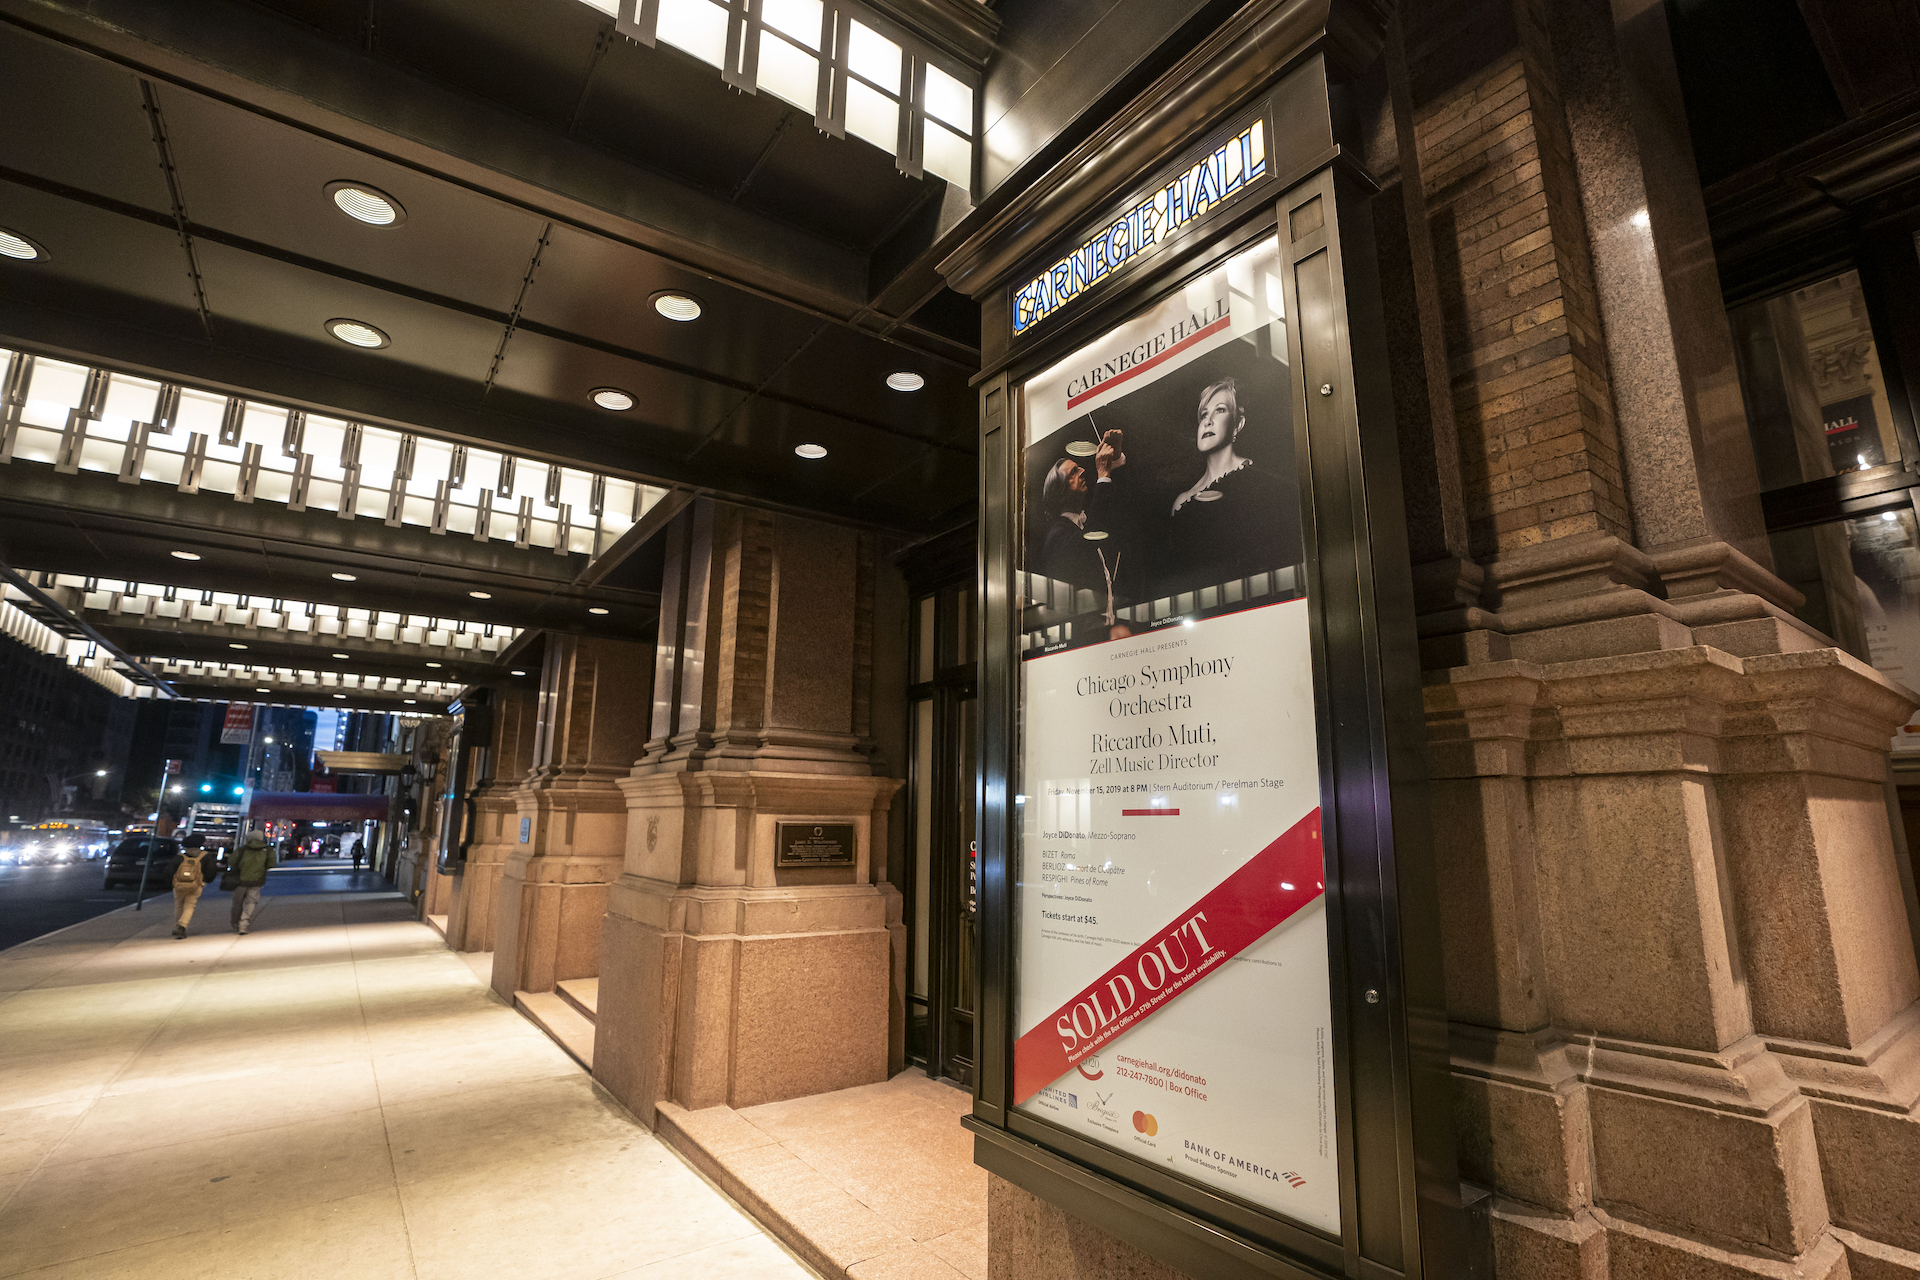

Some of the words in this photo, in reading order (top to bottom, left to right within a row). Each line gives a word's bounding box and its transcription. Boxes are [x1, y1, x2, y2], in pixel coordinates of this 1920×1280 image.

[1014, 202, 1155, 331] CARNEGIE
[1166, 132, 1266, 230] HALL
[1067, 332, 1166, 398] CARNEGIE
[1170, 297, 1230, 346] HALL
[1150, 620, 1162, 628] Joyce
[1110, 649, 1139, 661] CARNEGIE
[1140, 646, 1156, 655] HALL
[1157, 639, 1188, 651] PRESENTS
[1076, 673, 1136, 696] Chicago
[1140, 656, 1235, 688] Symphony
[1109, 693, 1193, 718] Orchestra
[1091, 727, 1163, 753] Riccardo
[1167, 722, 1217, 746] Muti,
[1089, 757, 1112, 775] Zell
[1115, 756, 1155, 773] Music
[1158, 752, 1219, 770] Director
[1096, 786, 1105, 795] 15,
[1106, 785, 1122, 794] 2019
[1122, 785, 1130, 793] at
[1130, 784, 1136, 793] 8
[1136, 784, 1148, 793] PM
[1153, 783, 1171, 792] Stern
[1172, 780, 1214, 792] Auditorium
[1221, 779, 1259, 789] Perelman
[1260, 777, 1285, 789] Stage
[1042, 831, 1058, 840] Joyce
[1058, 831, 1087, 840] DiDonato,
[1087, 831, 1137, 841] Mezzo-Soprano
[1042, 850, 1058, 859] BIZET
[1042, 862, 1066, 871] BERLIOZ
[1089, 865, 1097, 873] de
[1041, 873, 1069, 883] RESPIGHI
[1070, 875, 1085, 885] Pines
[1085, 876, 1092, 886] of
[1092, 877, 1109, 887] Rome
[1041, 909, 1061, 920] Tickets
[1061, 914, 1076, 922] start
[1077, 915, 1083, 923] at
[1084, 915, 1099, 925] $45.
[1056, 973, 1136, 1054] SOLD
[1137, 911, 1215, 991] OUT
[1067, 1050, 1083, 1063] Please
[1082, 1041, 1095, 1054] check
[1094, 1034, 1105, 1046] with
[1103, 1029, 1112, 1039] the
[1110, 1024, 1121, 1034] Box
[1119, 1014, 1134, 1028] Office
[1133, 1009, 1141, 1018] on
[1138, 1001, 1152, 1014] 57th
[1150, 990, 1167, 1006] Street
[1165, 985, 1174, 995] for
[1172, 979, 1183, 990] the
[1181, 968, 1198, 984] latest
[1196, 949, 1227, 973] availability.
[1116, 1054, 1208, 1086] carnegiehall.org/didonato
[1043, 1086, 1067, 1097] UNITED
[1116, 1066, 1164, 1088] 212-247-7800
[1169, 1081, 1183, 1094] Box
[1184, 1086, 1208, 1102] Office
[1038, 1090, 1067, 1104] AIRLINES
[1133, 1135, 1147, 1145] Official
[1147, 1139, 1157, 1148] Card
[1184, 1139, 1211, 1157] BANK
[1213, 1150, 1226, 1162] OF
[1228, 1156, 1280, 1182] AMERICA
[1184, 1153, 1199, 1164] Proud
[1199, 1159, 1216, 1171] Season
[1216, 1166, 1238, 1179] Sponsor
